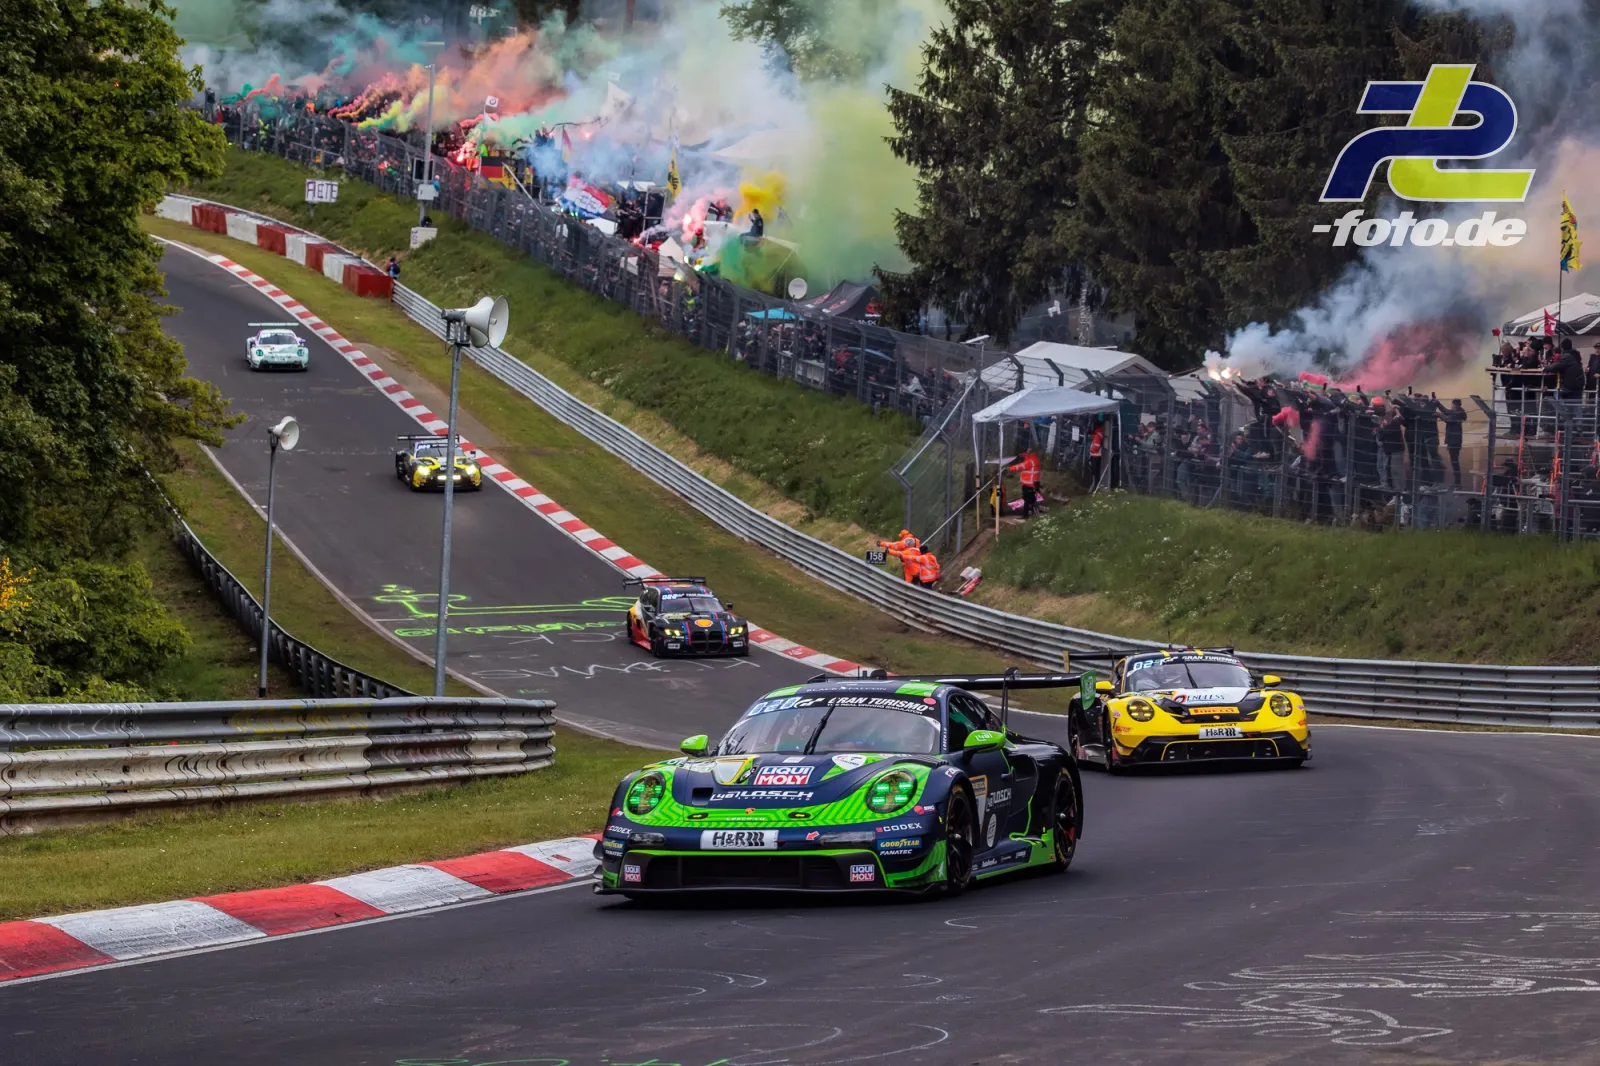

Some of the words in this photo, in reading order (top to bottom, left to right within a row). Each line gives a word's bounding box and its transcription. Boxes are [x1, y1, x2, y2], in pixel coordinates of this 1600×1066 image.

[869, 552, 884, 560] 158
[869, 697, 929, 712] TURISMO
[761, 766, 811, 775] LIQUI
[756, 775, 808, 785] MOLY
[741, 790, 815, 798] LOSCH
[609, 825, 632, 835] CODEX
[883, 822, 923, 832] CODEX
[880, 838, 920, 848] GOODYEAR
[625, 865, 640, 873] LIQUI
[852, 865, 873, 873] LIQUI
[625, 873, 641, 881] MOLY
[852, 873, 874, 881] MOLY
